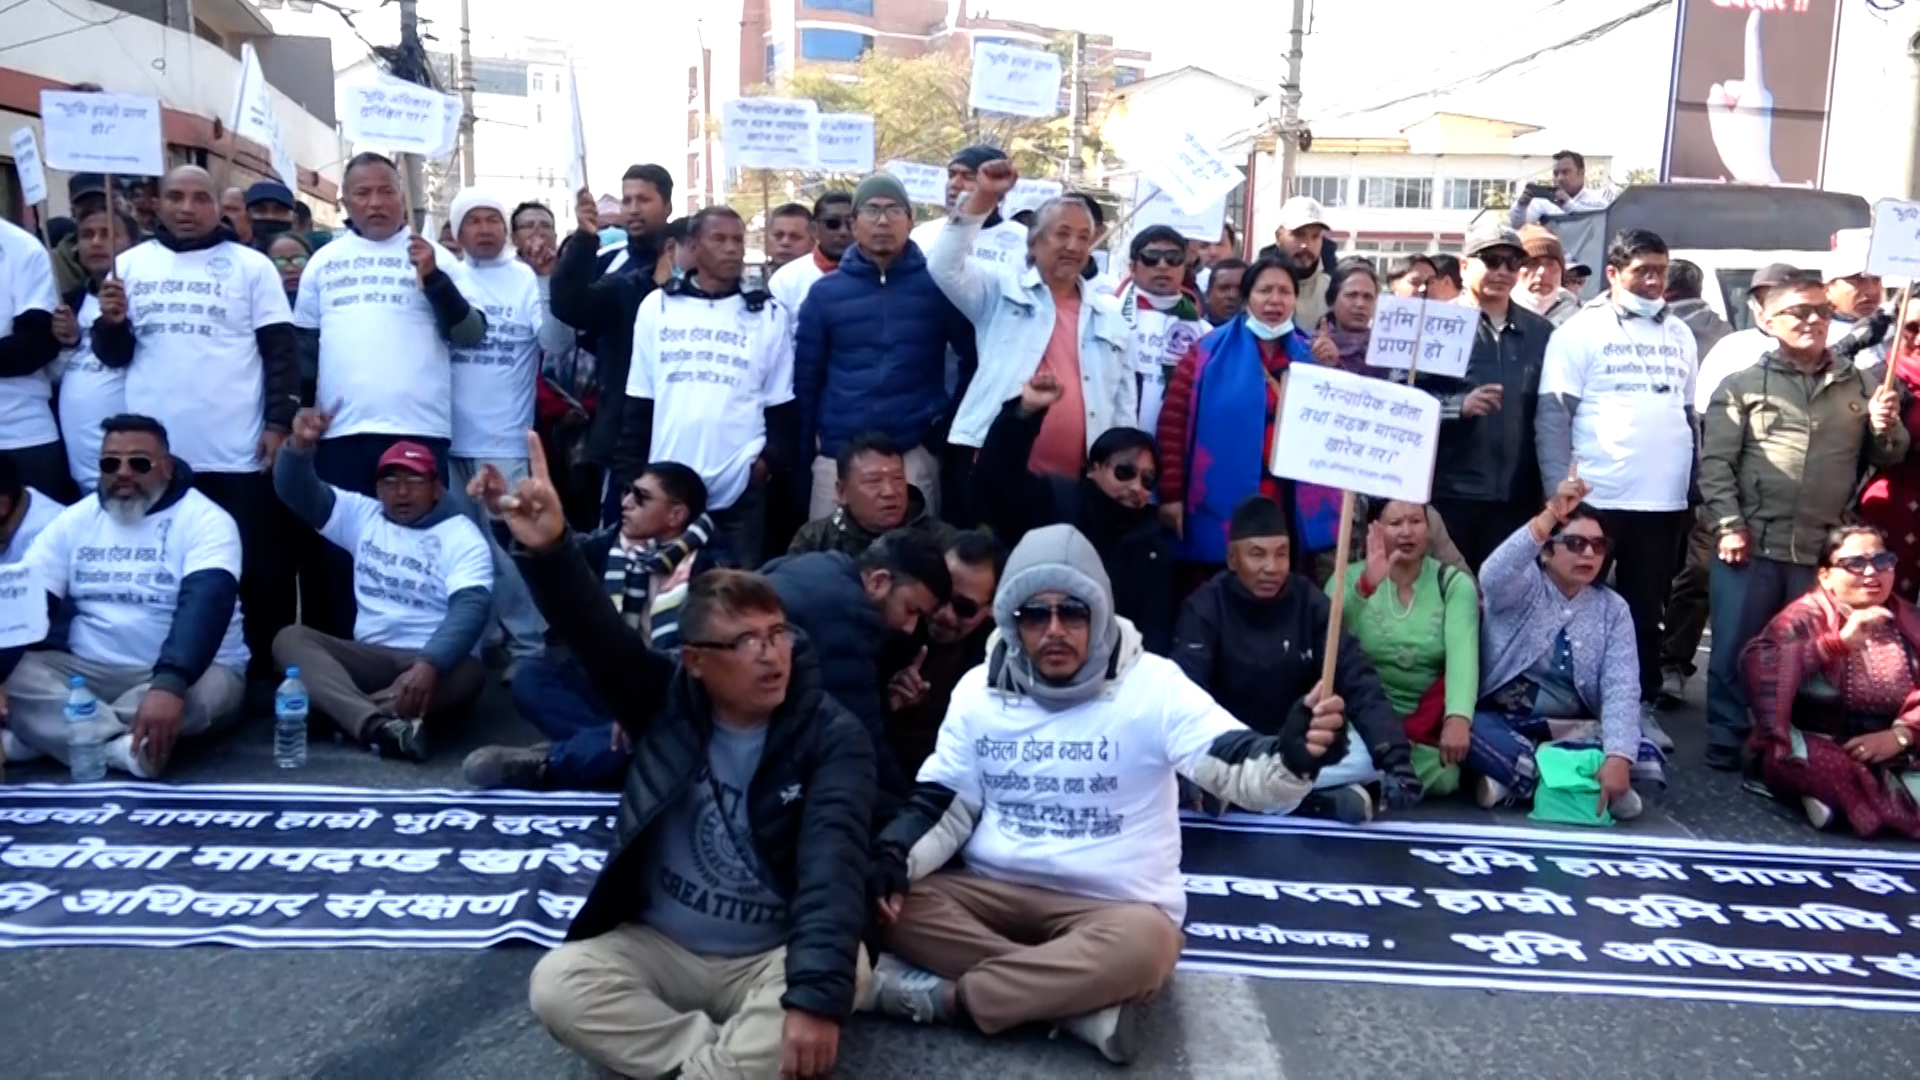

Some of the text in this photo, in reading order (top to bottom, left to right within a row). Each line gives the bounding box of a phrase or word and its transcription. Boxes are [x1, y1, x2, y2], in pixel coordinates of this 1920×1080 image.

[1021, 735, 1054, 763] होइन
[1058, 740, 1094, 761] न्याय
[1098, 734, 1109, 762] दे
[128, 807, 275, 829] नाममा
[275, 806, 384, 830] हाम्रो
[192, 845, 454, 874] मापदण्ड
[1409, 846, 1917, 895] भूमि हाम्रो प्राण हो
[61, 884, 320, 918] अधिकार
[324, 888, 530, 920] संरक्षण
[1423, 886, 1578, 916] हाम्रो
[1585, 892, 1731, 928] भूमि
[1728, 902, 1902, 935] माथि
[1184, 922, 1371, 948] आयोजक
[1449, 928, 1588, 965] भूमि
[1599, 937, 1871, 978] अधिकार
